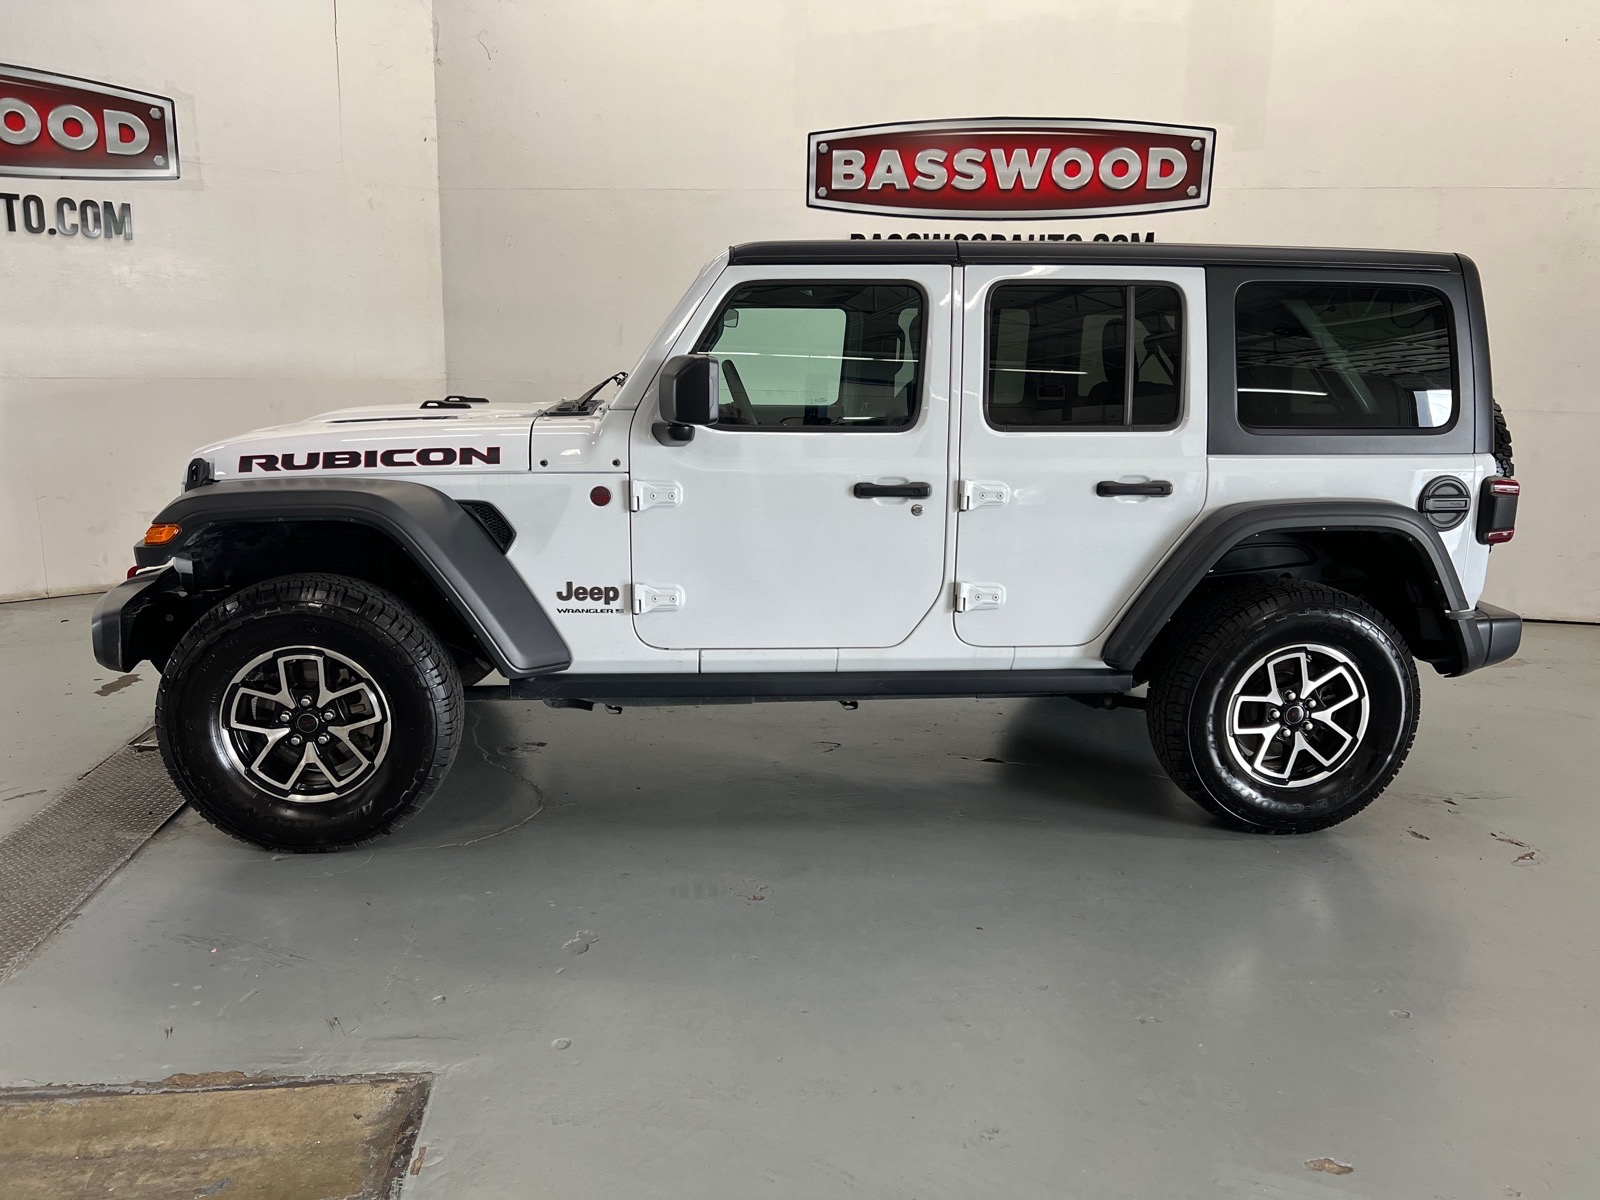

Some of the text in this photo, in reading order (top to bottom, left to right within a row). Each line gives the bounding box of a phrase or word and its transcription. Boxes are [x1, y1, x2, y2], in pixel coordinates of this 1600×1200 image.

[831, 147, 1188, 191] BASSWOOD
[238, 446, 501, 473] RUBICON
[556, 581, 620, 605] Jeep
